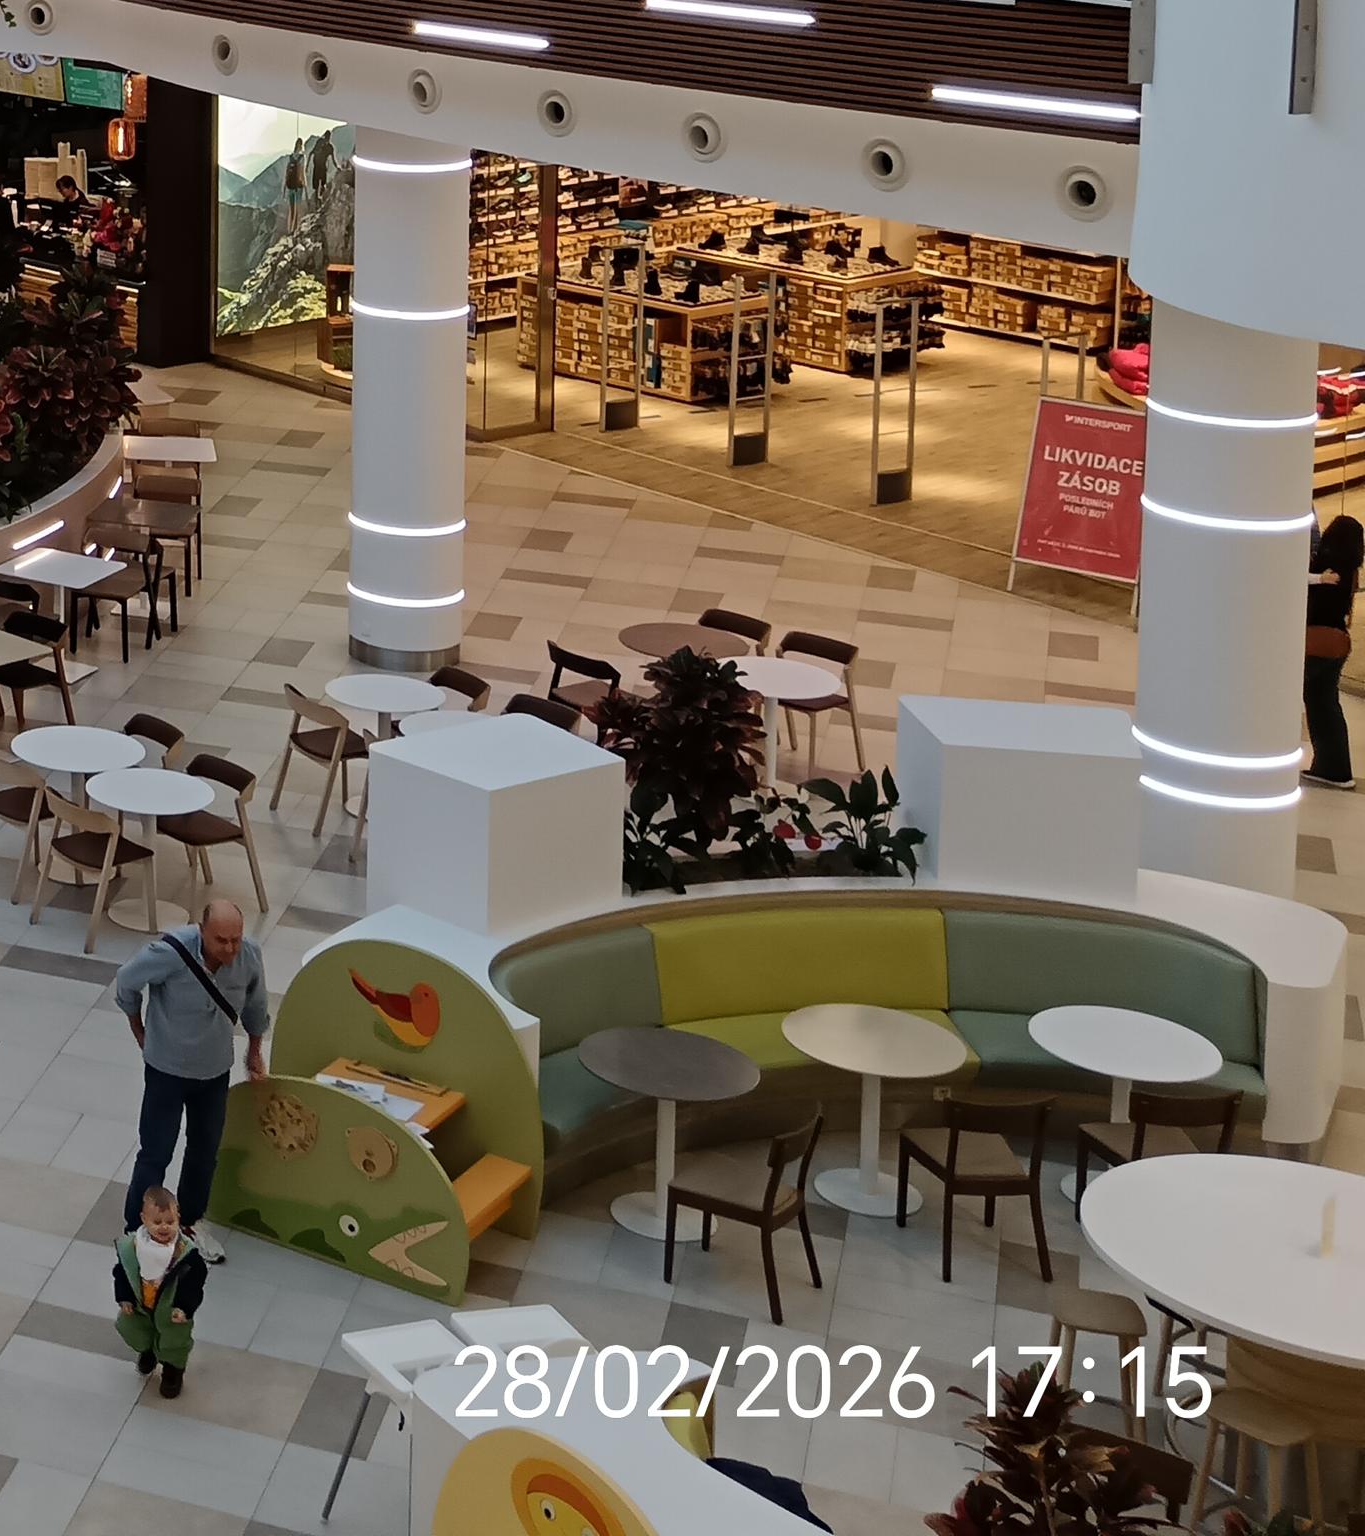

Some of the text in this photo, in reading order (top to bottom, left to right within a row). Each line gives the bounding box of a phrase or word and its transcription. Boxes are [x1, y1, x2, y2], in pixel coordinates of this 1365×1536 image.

[1073, 415, 1134, 433] INTERSPORT
[1043, 444, 1145, 477] LIKVIDACE
[1057, 470, 1121, 496] ZÁSOB
[1058, 492, 1114, 510] POSLEDNÍCH
